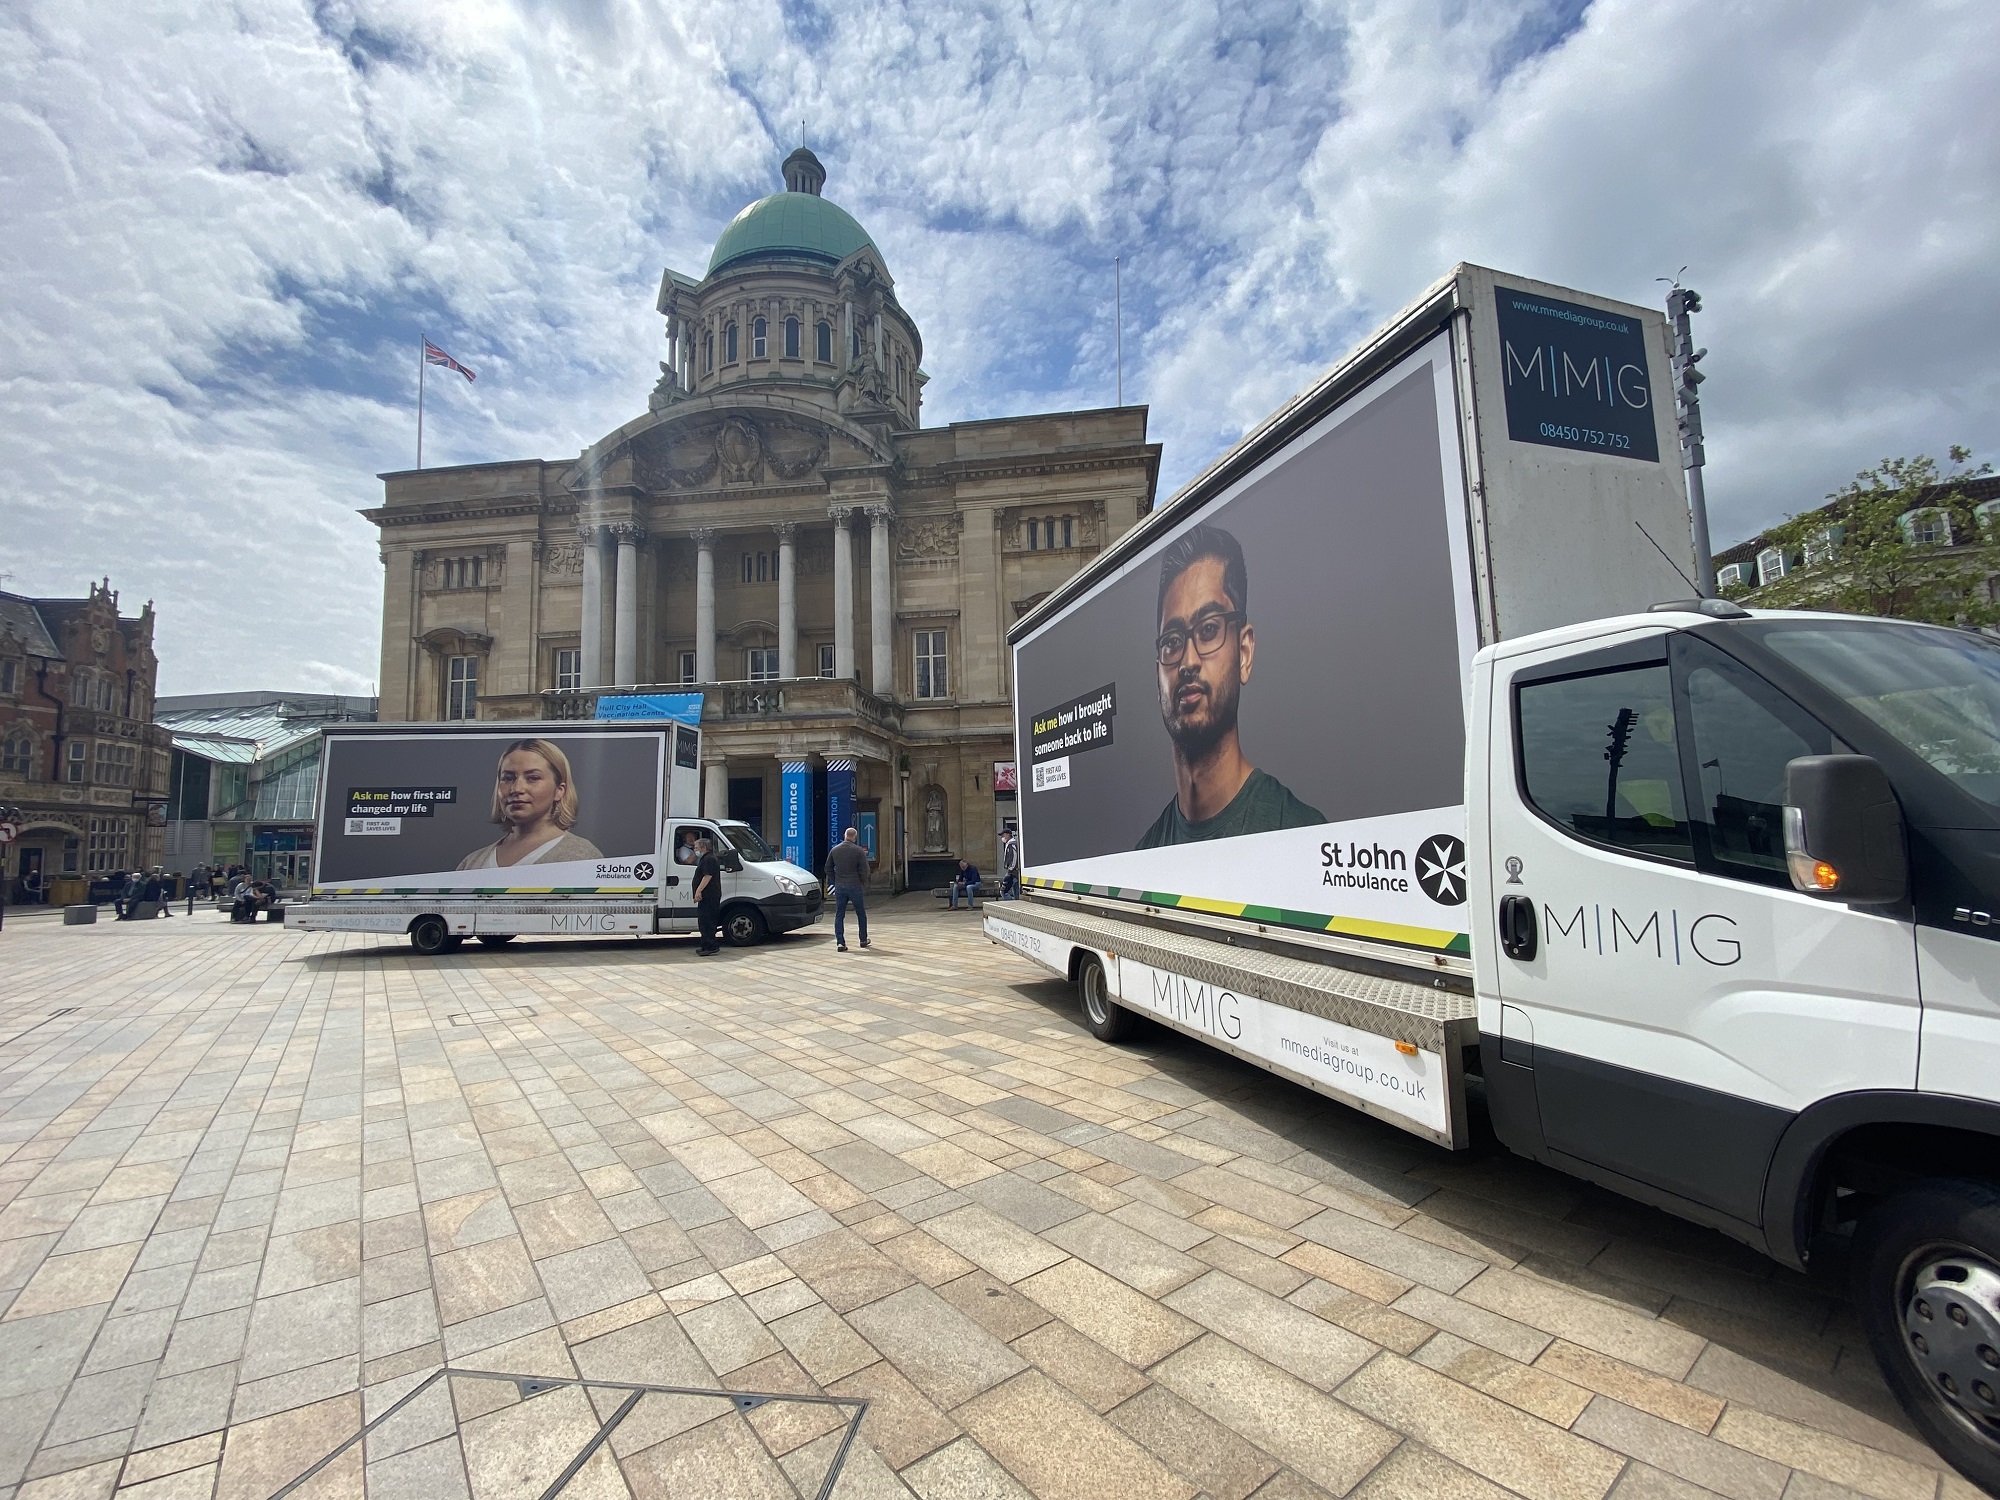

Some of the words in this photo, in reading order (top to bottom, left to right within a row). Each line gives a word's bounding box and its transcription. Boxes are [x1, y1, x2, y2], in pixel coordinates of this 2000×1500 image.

[1512, 300, 1629, 334] www.mmediagroup.co.uk
[1539, 422, 1579, 442] 08450
[1581, 428, 1605, 445] 752
[1607, 432, 1631, 449] 752
[1033, 719, 1046, 735] Ask
[1047, 717, 1058, 730] me
[1058, 712, 1074, 727] how
[1074, 705, 1077, 720] I
[1079, 693, 1112, 719] brought
[1034, 737, 1064, 756] someone
[1064, 729, 1082, 747] back
[1083, 727, 1092, 741] to
[1093, 720, 1107, 739] life
[1045, 766, 1055, 774] FIRST
[1045, 775, 1056, 783] SAVES
[1057, 773, 1066, 781] LIVES
[352, 791, 372, 800] Ask
[391, 791, 411, 800] how
[413, 791, 434, 800] first
[435, 791, 451, 800] aid
[351, 803, 392, 814] changed
[394, 806, 409, 814] my
[411, 803, 427, 813] life
[787, 782, 798, 838] Entrance
[1320, 842, 1344, 868] St
[1347, 842, 1407, 870] John
[596, 864, 606, 873] St
[608, 864, 631, 873] John
[1322, 870, 1409, 892] Ambulance
[384, 918, 401, 927] 752
[1017, 932, 1029, 948] 752
[1029, 936, 1041, 953] 752
[1323, 1036, 1339, 1050] Visit
[1340, 1044, 1350, 1053] us
[1351, 1046, 1359, 1057] at
[1280, 1037, 1426, 1101] mmediagroup.co.uk
